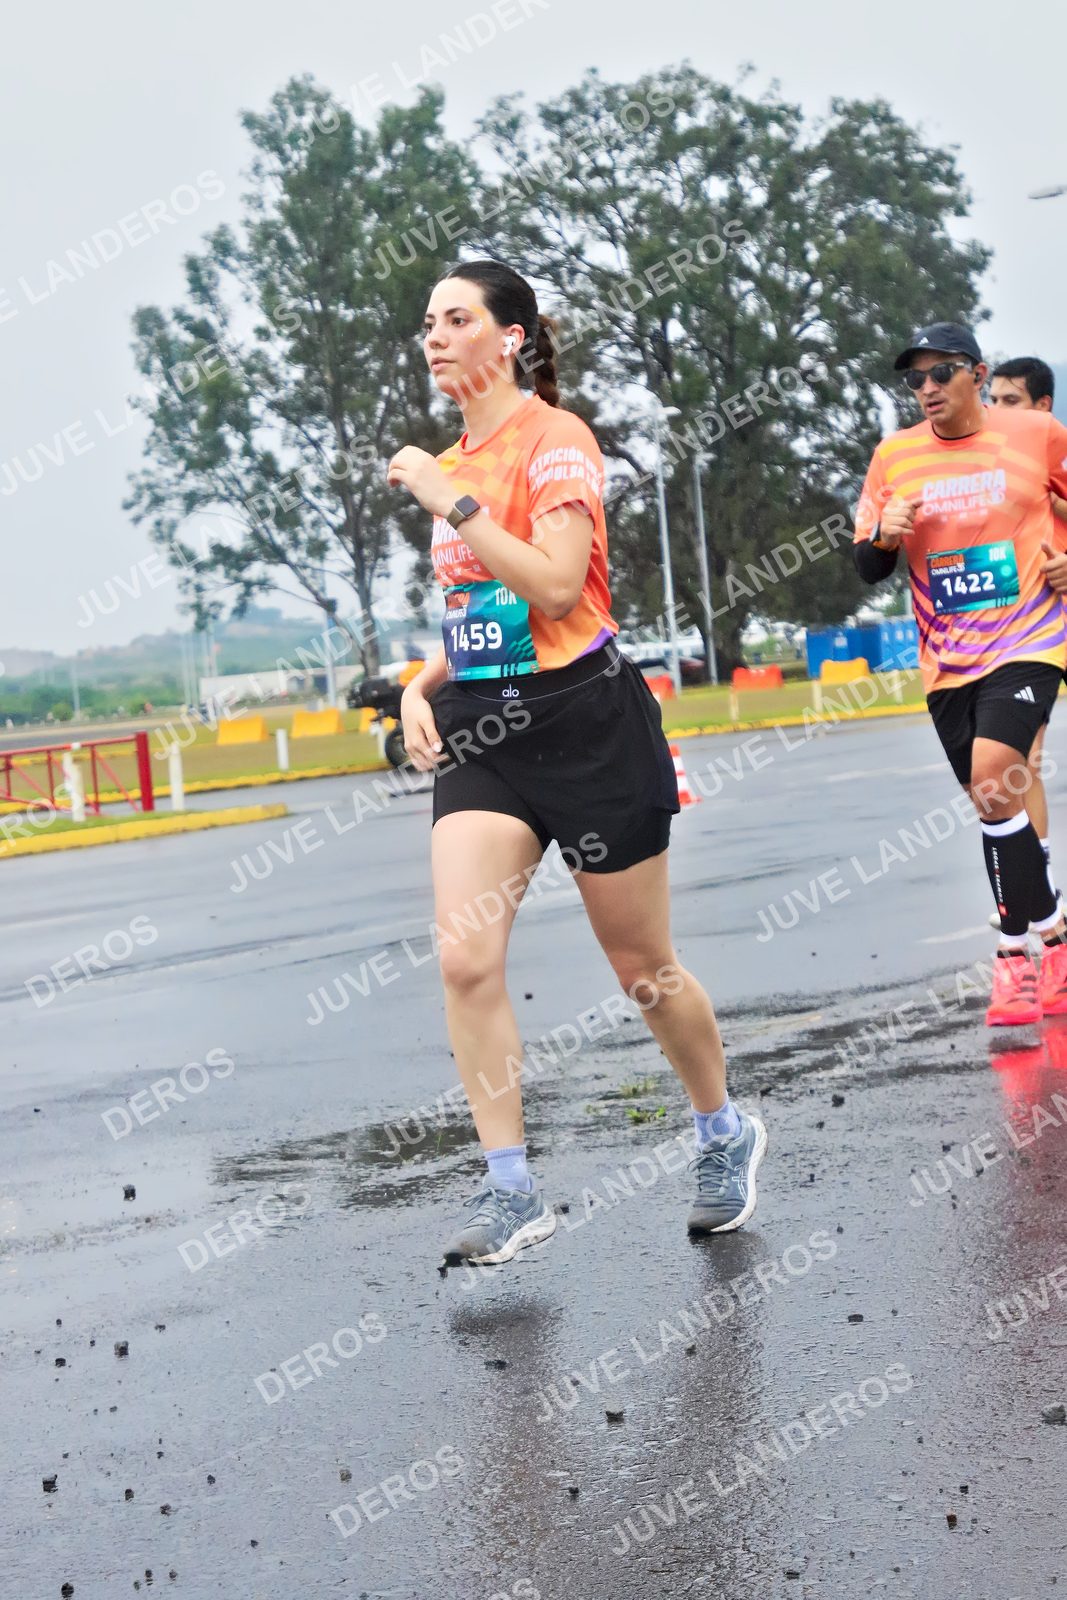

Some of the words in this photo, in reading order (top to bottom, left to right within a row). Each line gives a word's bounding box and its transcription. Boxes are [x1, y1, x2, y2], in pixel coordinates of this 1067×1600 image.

[922, 469, 1006, 501] CARRERA
[989, 546, 1007, 561] 10K
[941, 571, 996, 596] 1422
[495, 586, 517, 606] 10K
[451, 621, 503, 653] 1459
[502, 683, 520, 698] alo
